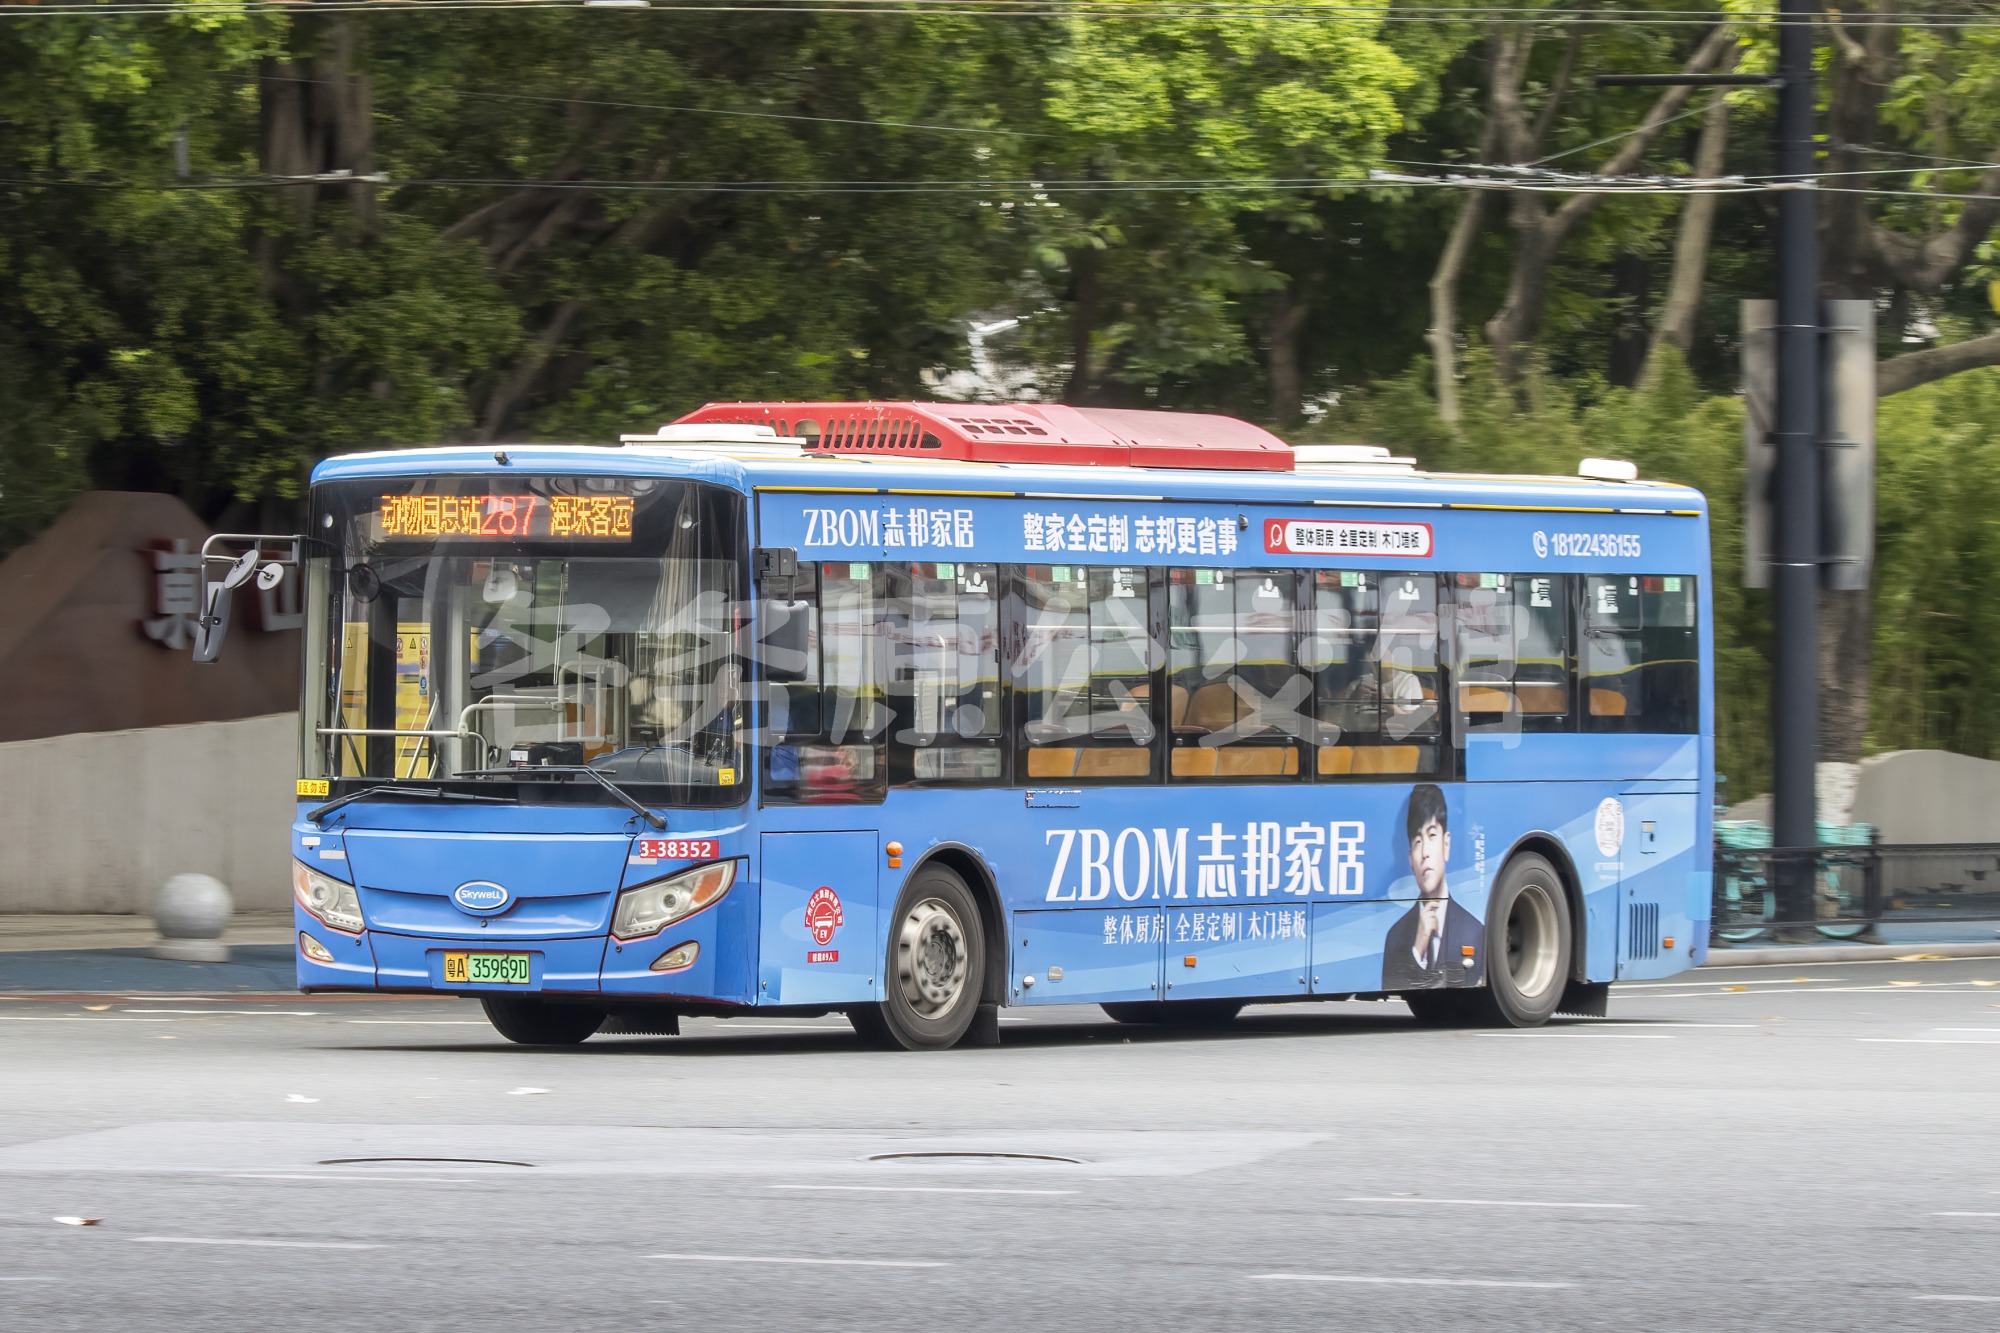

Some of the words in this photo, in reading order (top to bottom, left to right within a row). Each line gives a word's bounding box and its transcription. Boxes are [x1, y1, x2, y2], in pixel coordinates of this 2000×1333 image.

[381, 495, 480, 535] 动物园总站
[480, 496, 536, 536] 287
[550, 496, 634, 536] 海珠客运
[802, 508, 879, 546] ZBOM
[882, 509, 974, 548] 志邦家居
[1023, 512, 1128, 553] 整家全定制
[1135, 514, 1238, 556] 志邦更省事
[1551, 532, 1641, 558] 18122436155
[640, 841, 711, 858] 3-38352
[1045, 827, 1190, 902] ZBOM
[1197, 821, 1365, 898] 志邦家居
[1102, 914, 1164, 945] 整体厨房
[1174, 911, 1236, 943] 全屋定制
[1246, 909, 1307, 941] 木门墙板
[447, 958, 466, 978] 粤A
[472, 958, 528, 979] 35969D
